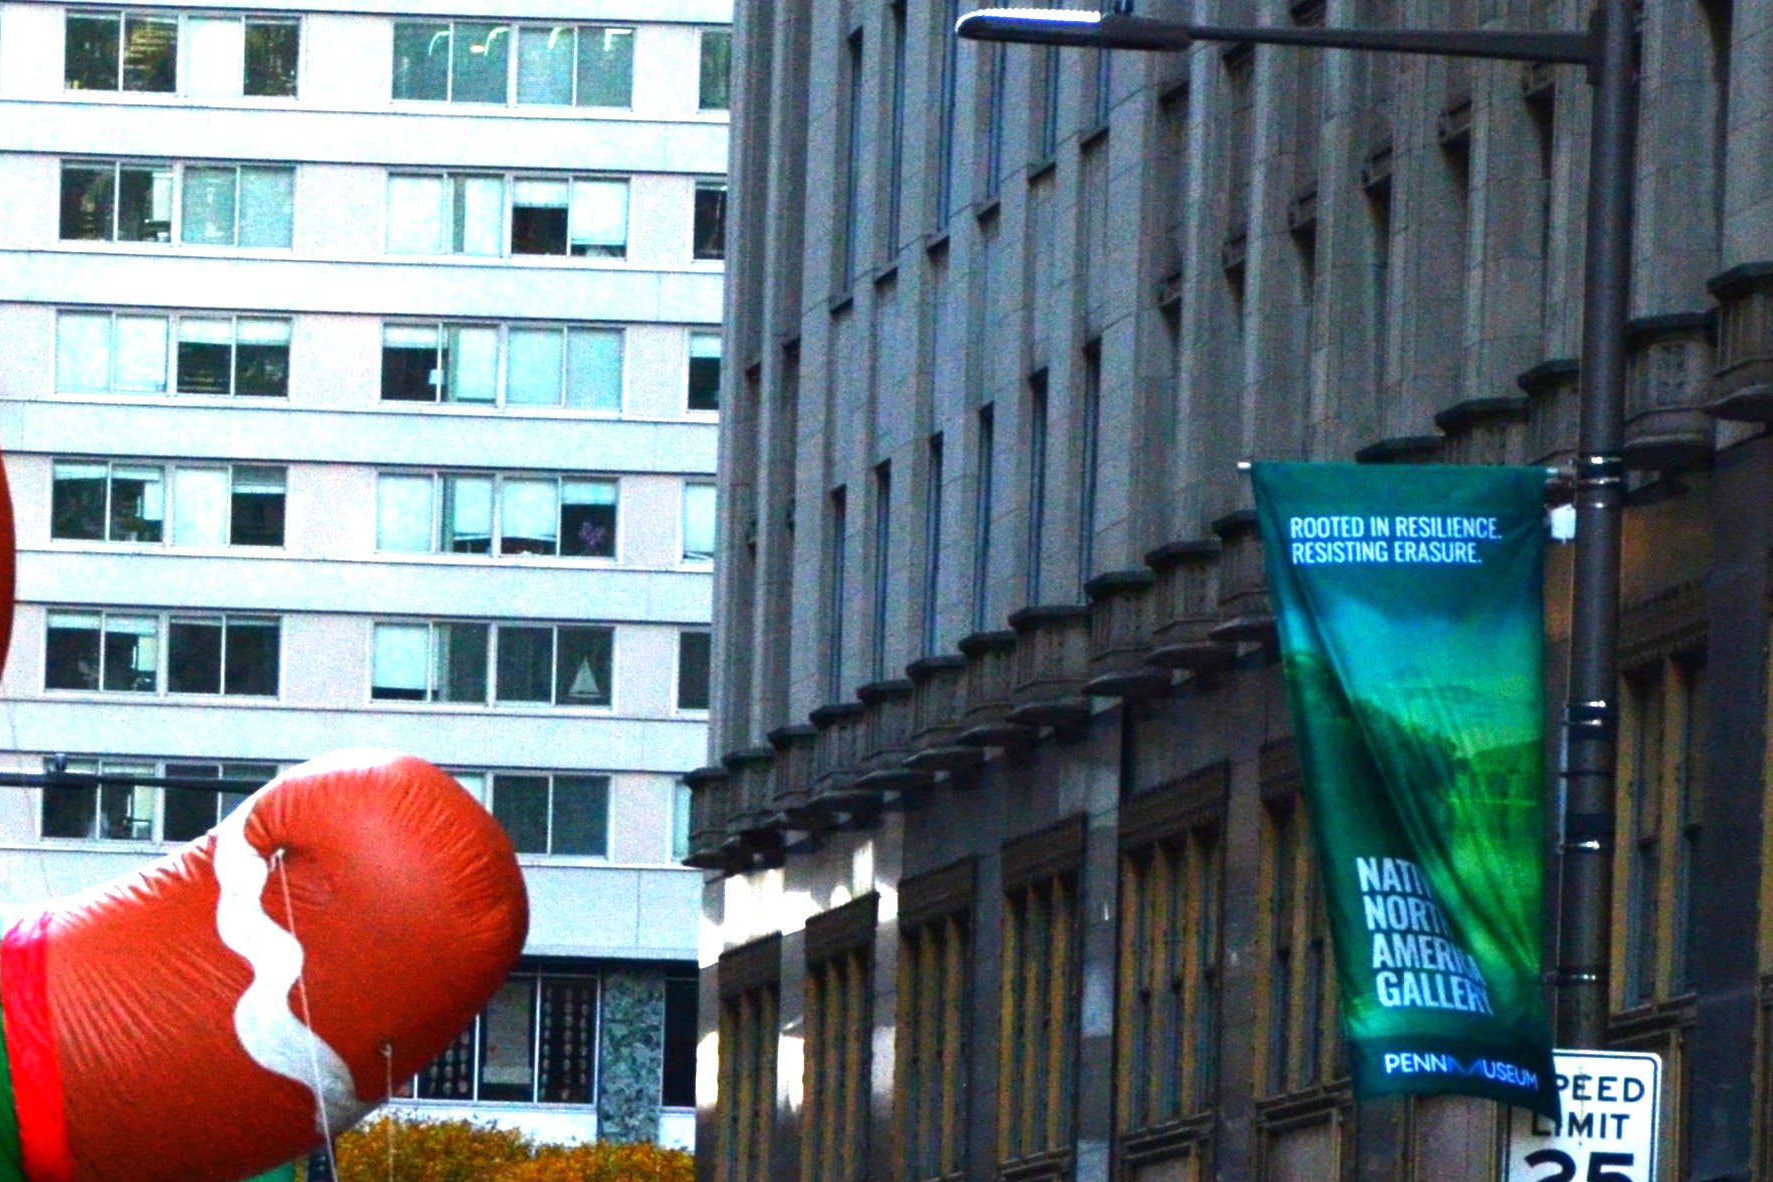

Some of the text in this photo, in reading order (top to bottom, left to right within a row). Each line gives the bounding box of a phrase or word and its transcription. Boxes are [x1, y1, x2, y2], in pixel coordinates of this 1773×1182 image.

[1290, 516, 1503, 540] ROOTED IN RESILIENCE.
[1292, 541, 1483, 565] RESISTING ERASURE.
[1356, 856, 1431, 899] NATI
[1554, 1073, 1646, 1103] PEED
